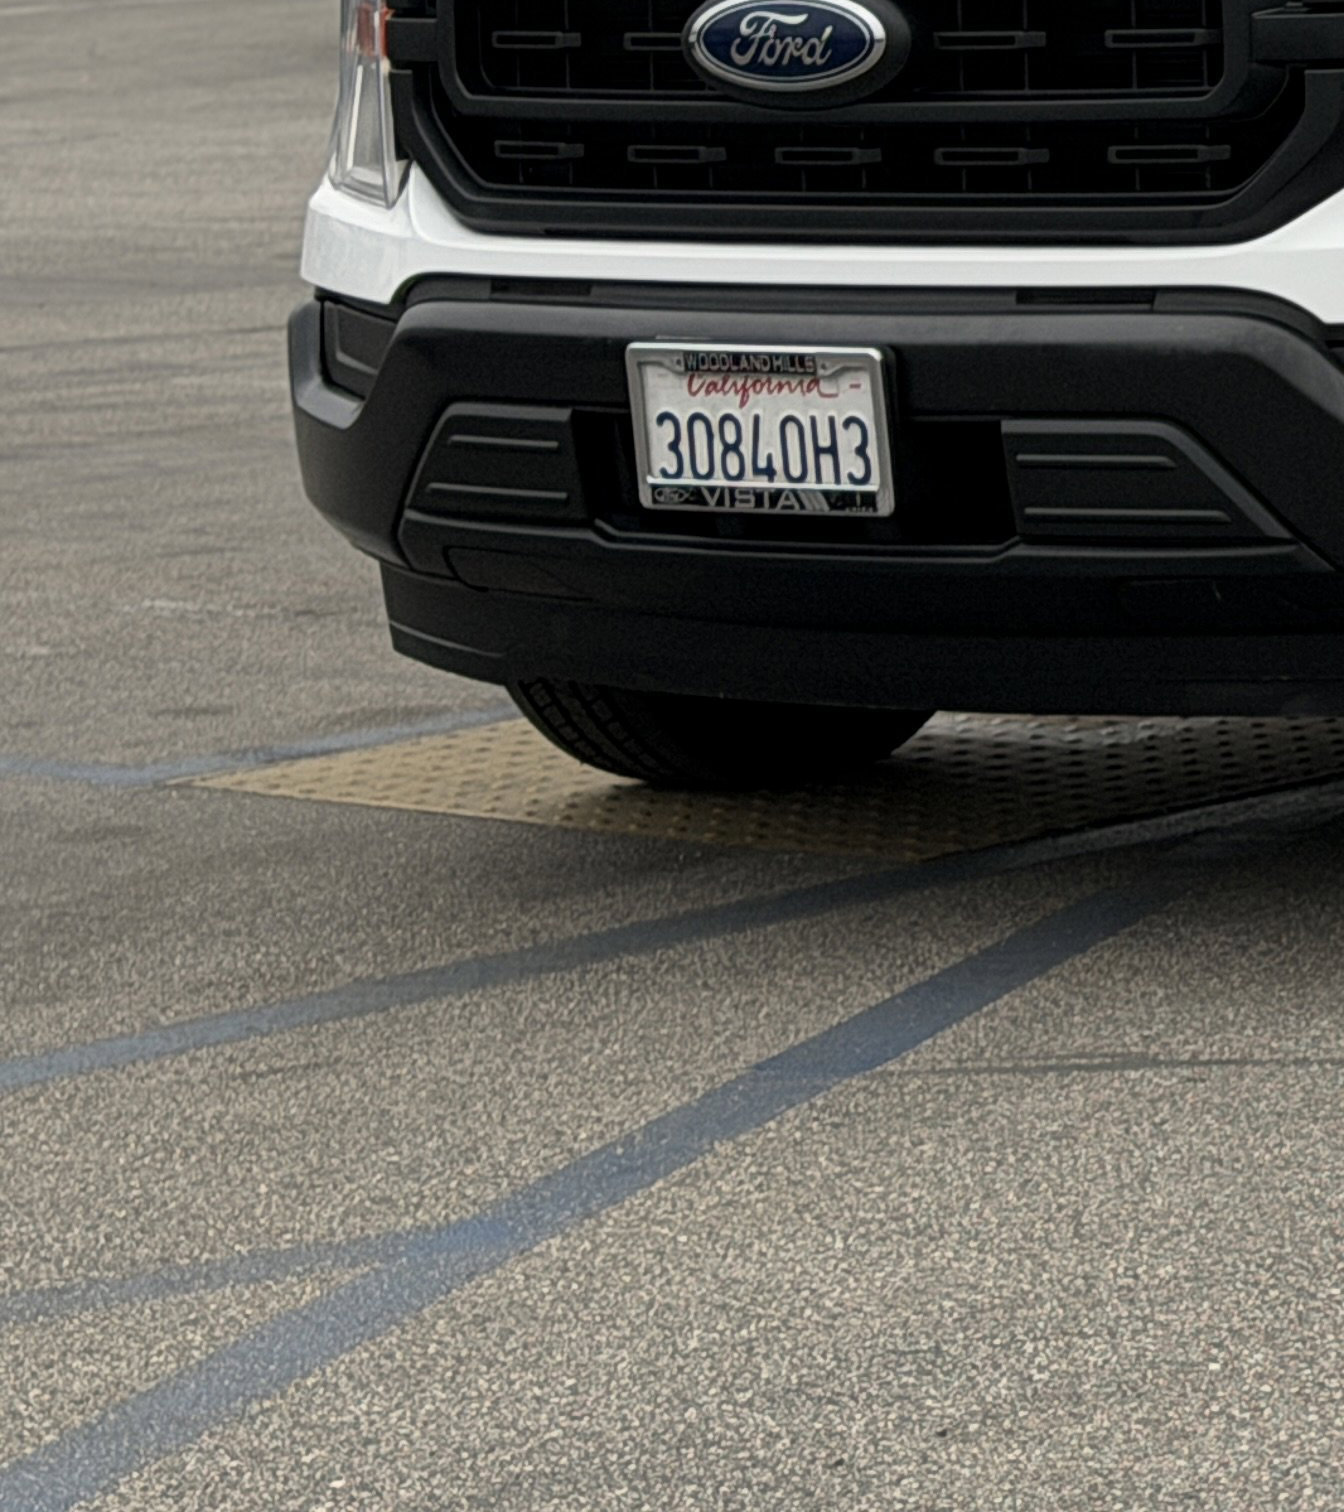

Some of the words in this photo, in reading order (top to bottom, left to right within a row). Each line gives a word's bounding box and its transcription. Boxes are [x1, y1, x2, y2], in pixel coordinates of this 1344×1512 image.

[729, 10, 834, 67] Ford
[686, 352, 771, 372] WOODLAND
[772, 355, 816, 373] HILLS
[686, 373, 839, 408] California
[656, 411, 873, 486] 30840H3
[701, 486, 801, 513] VISTA
